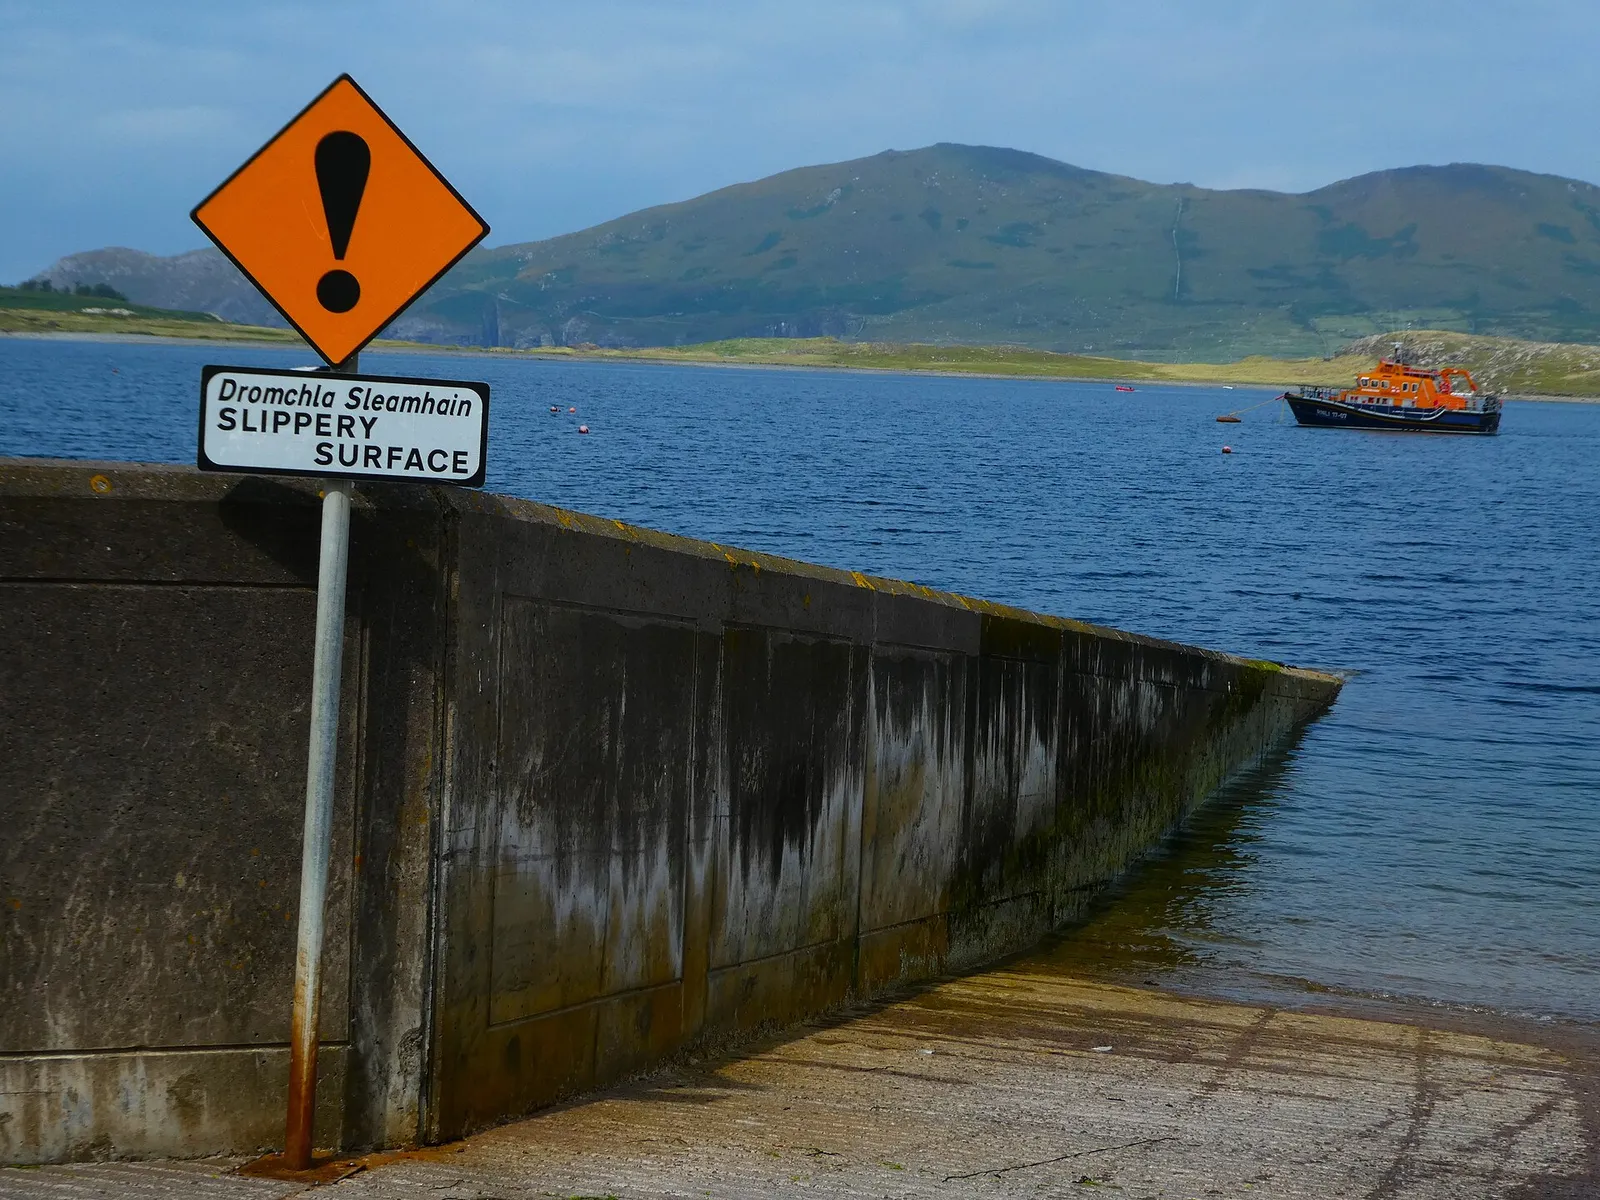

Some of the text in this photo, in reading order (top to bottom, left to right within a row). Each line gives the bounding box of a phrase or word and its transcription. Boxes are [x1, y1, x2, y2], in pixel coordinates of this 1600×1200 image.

[218, 378, 472, 417] Dromchla Sleamhain
[217, 407, 378, 439] SLIPPERY
[313, 442, 469, 474] SURFACE
